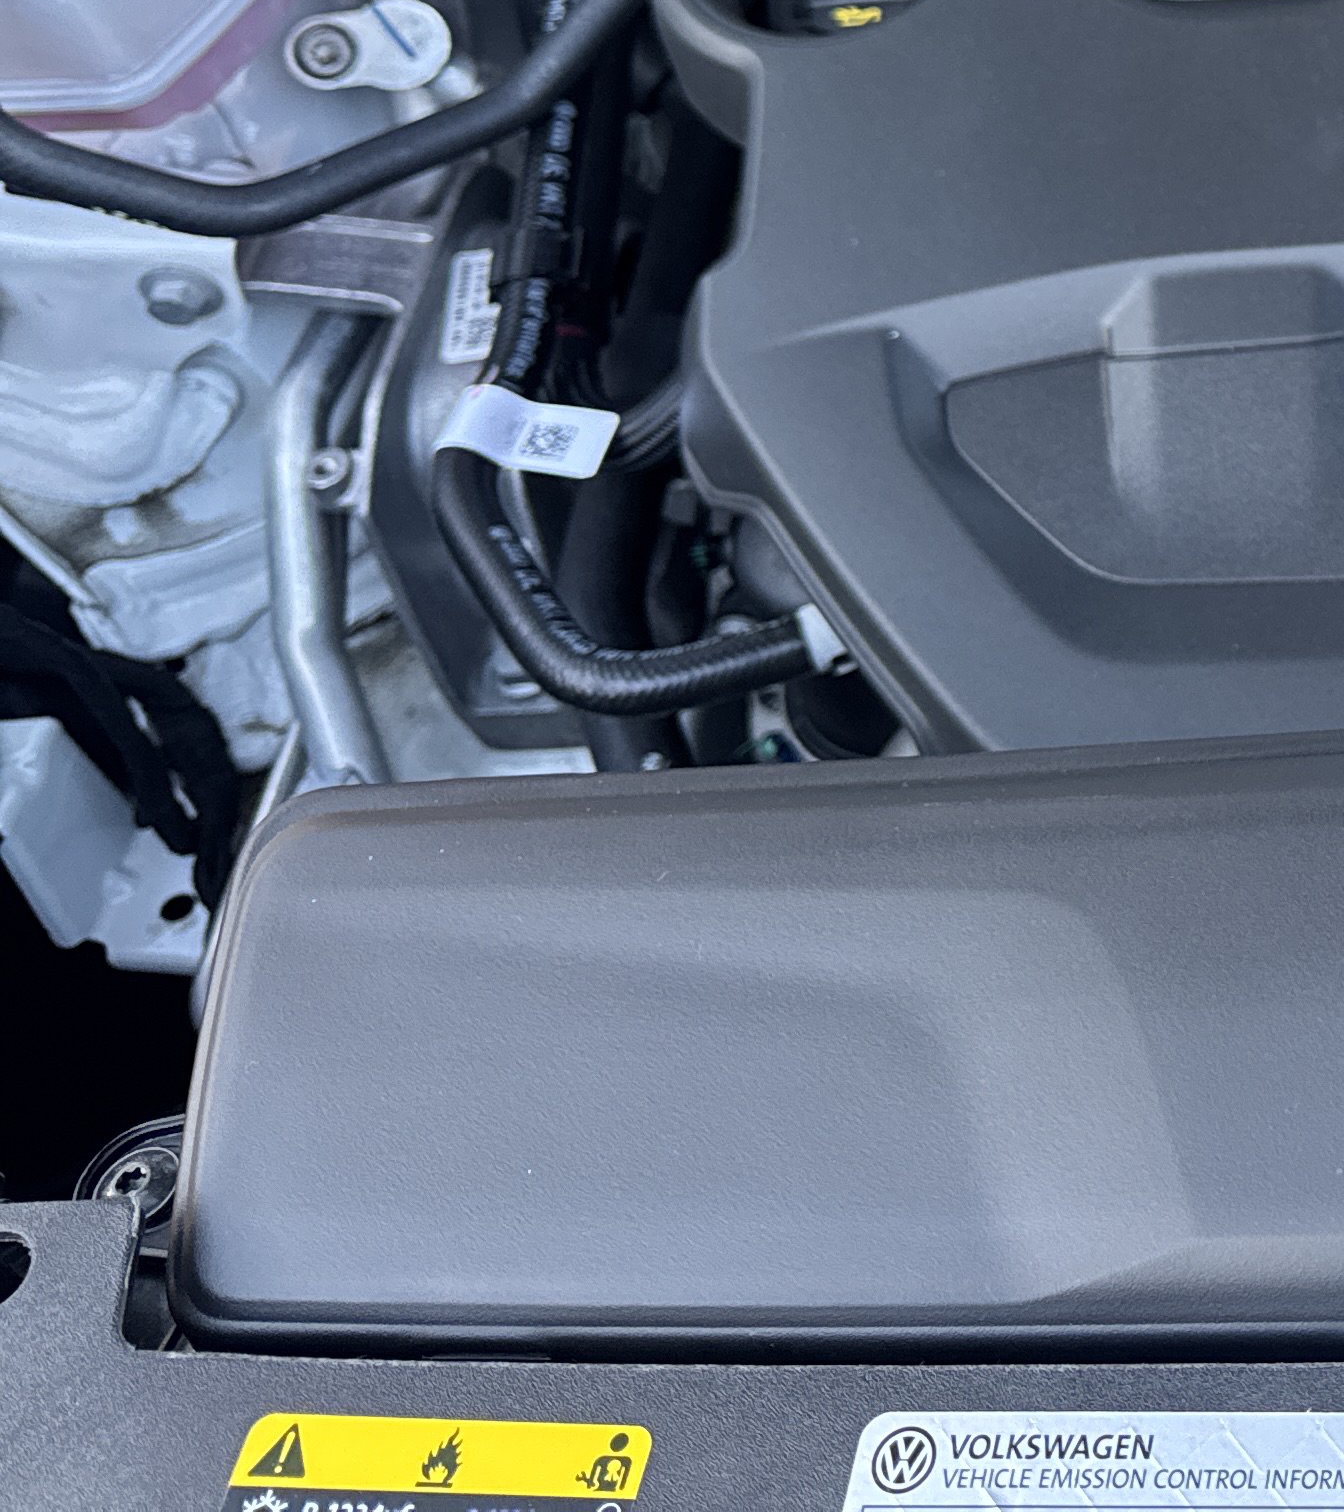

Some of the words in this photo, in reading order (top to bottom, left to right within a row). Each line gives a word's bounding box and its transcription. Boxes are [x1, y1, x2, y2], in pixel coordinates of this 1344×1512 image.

[950, 1434, 1154, 1460] VOLKSWAGEN
[942, 1468, 1031, 1489] VEHICLE
[1038, 1468, 1147, 1489] EMISSION
[1153, 1468, 1258, 1490] CONTROL
